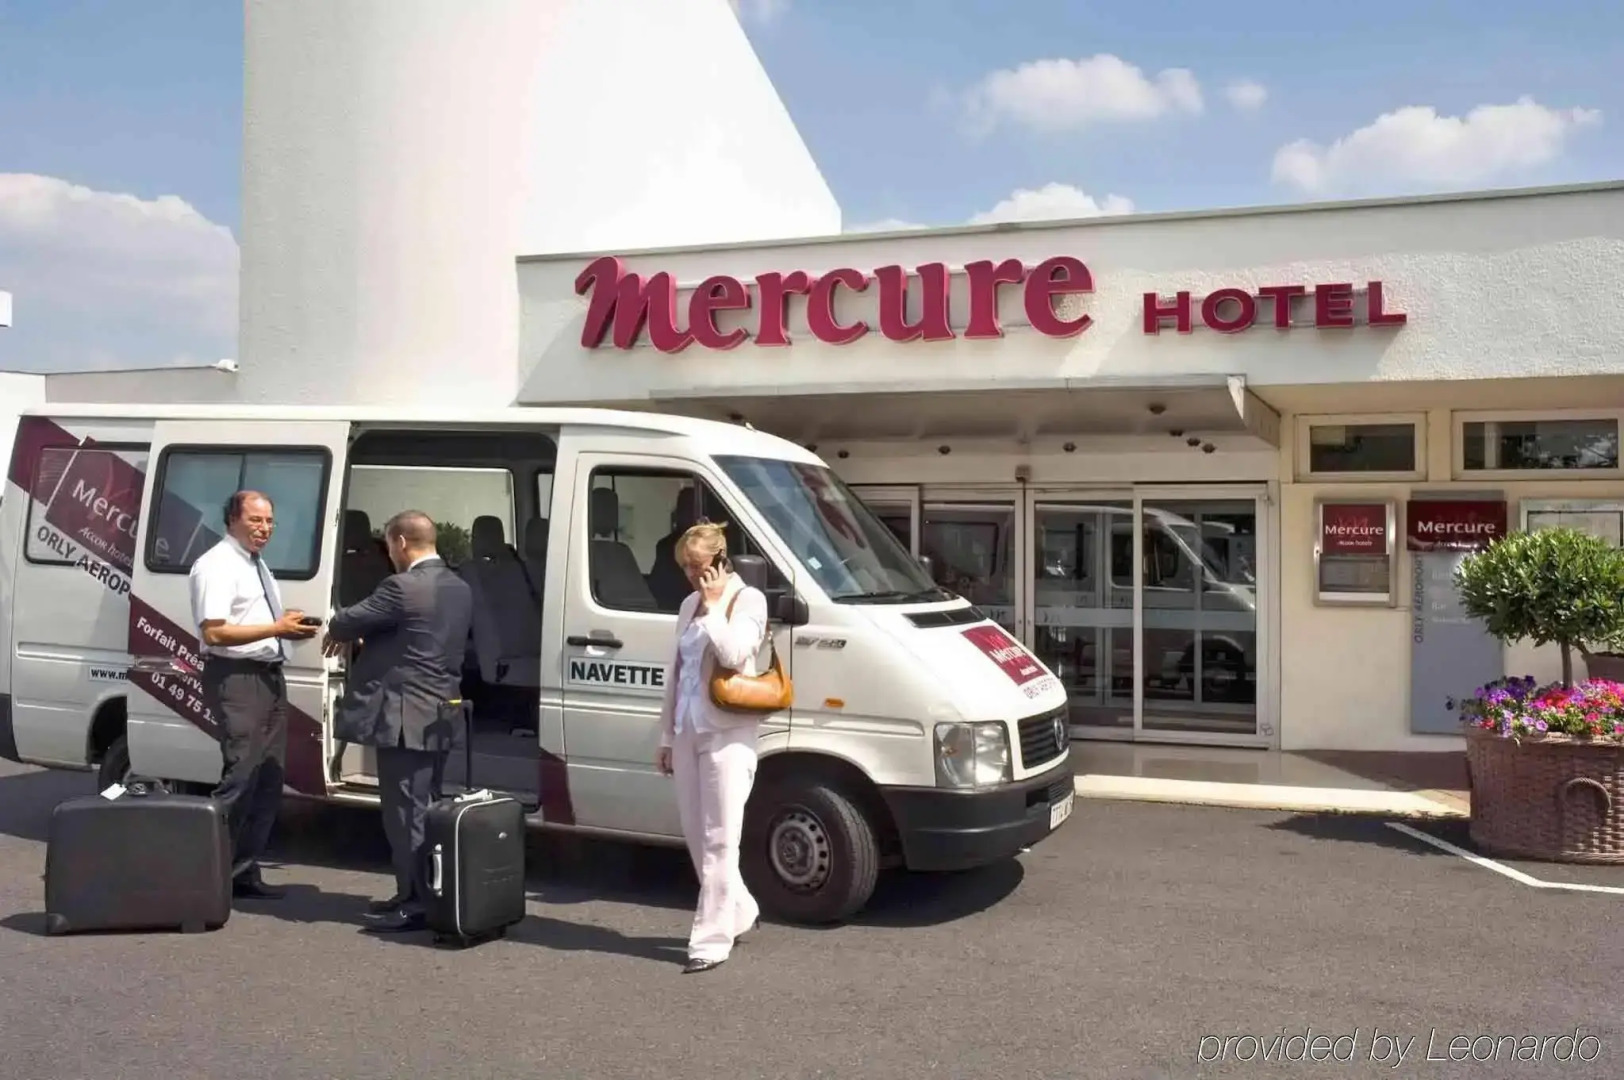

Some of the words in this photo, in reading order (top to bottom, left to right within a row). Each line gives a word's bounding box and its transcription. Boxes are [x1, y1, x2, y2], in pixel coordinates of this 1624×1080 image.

[1143, 279, 1408, 335] HOTEL
[37, 525, 77, 560] ORLY
[1325, 524, 1384, 535] Mercure
[1417, 520, 1496, 534] Mercure
[136, 616, 177, 652] Forfait
[571, 661, 664, 686] NAVETTE
[151, 672, 167, 690] 01
[168, 684, 185, 700] 49
[186, 696, 202, 713] 75
